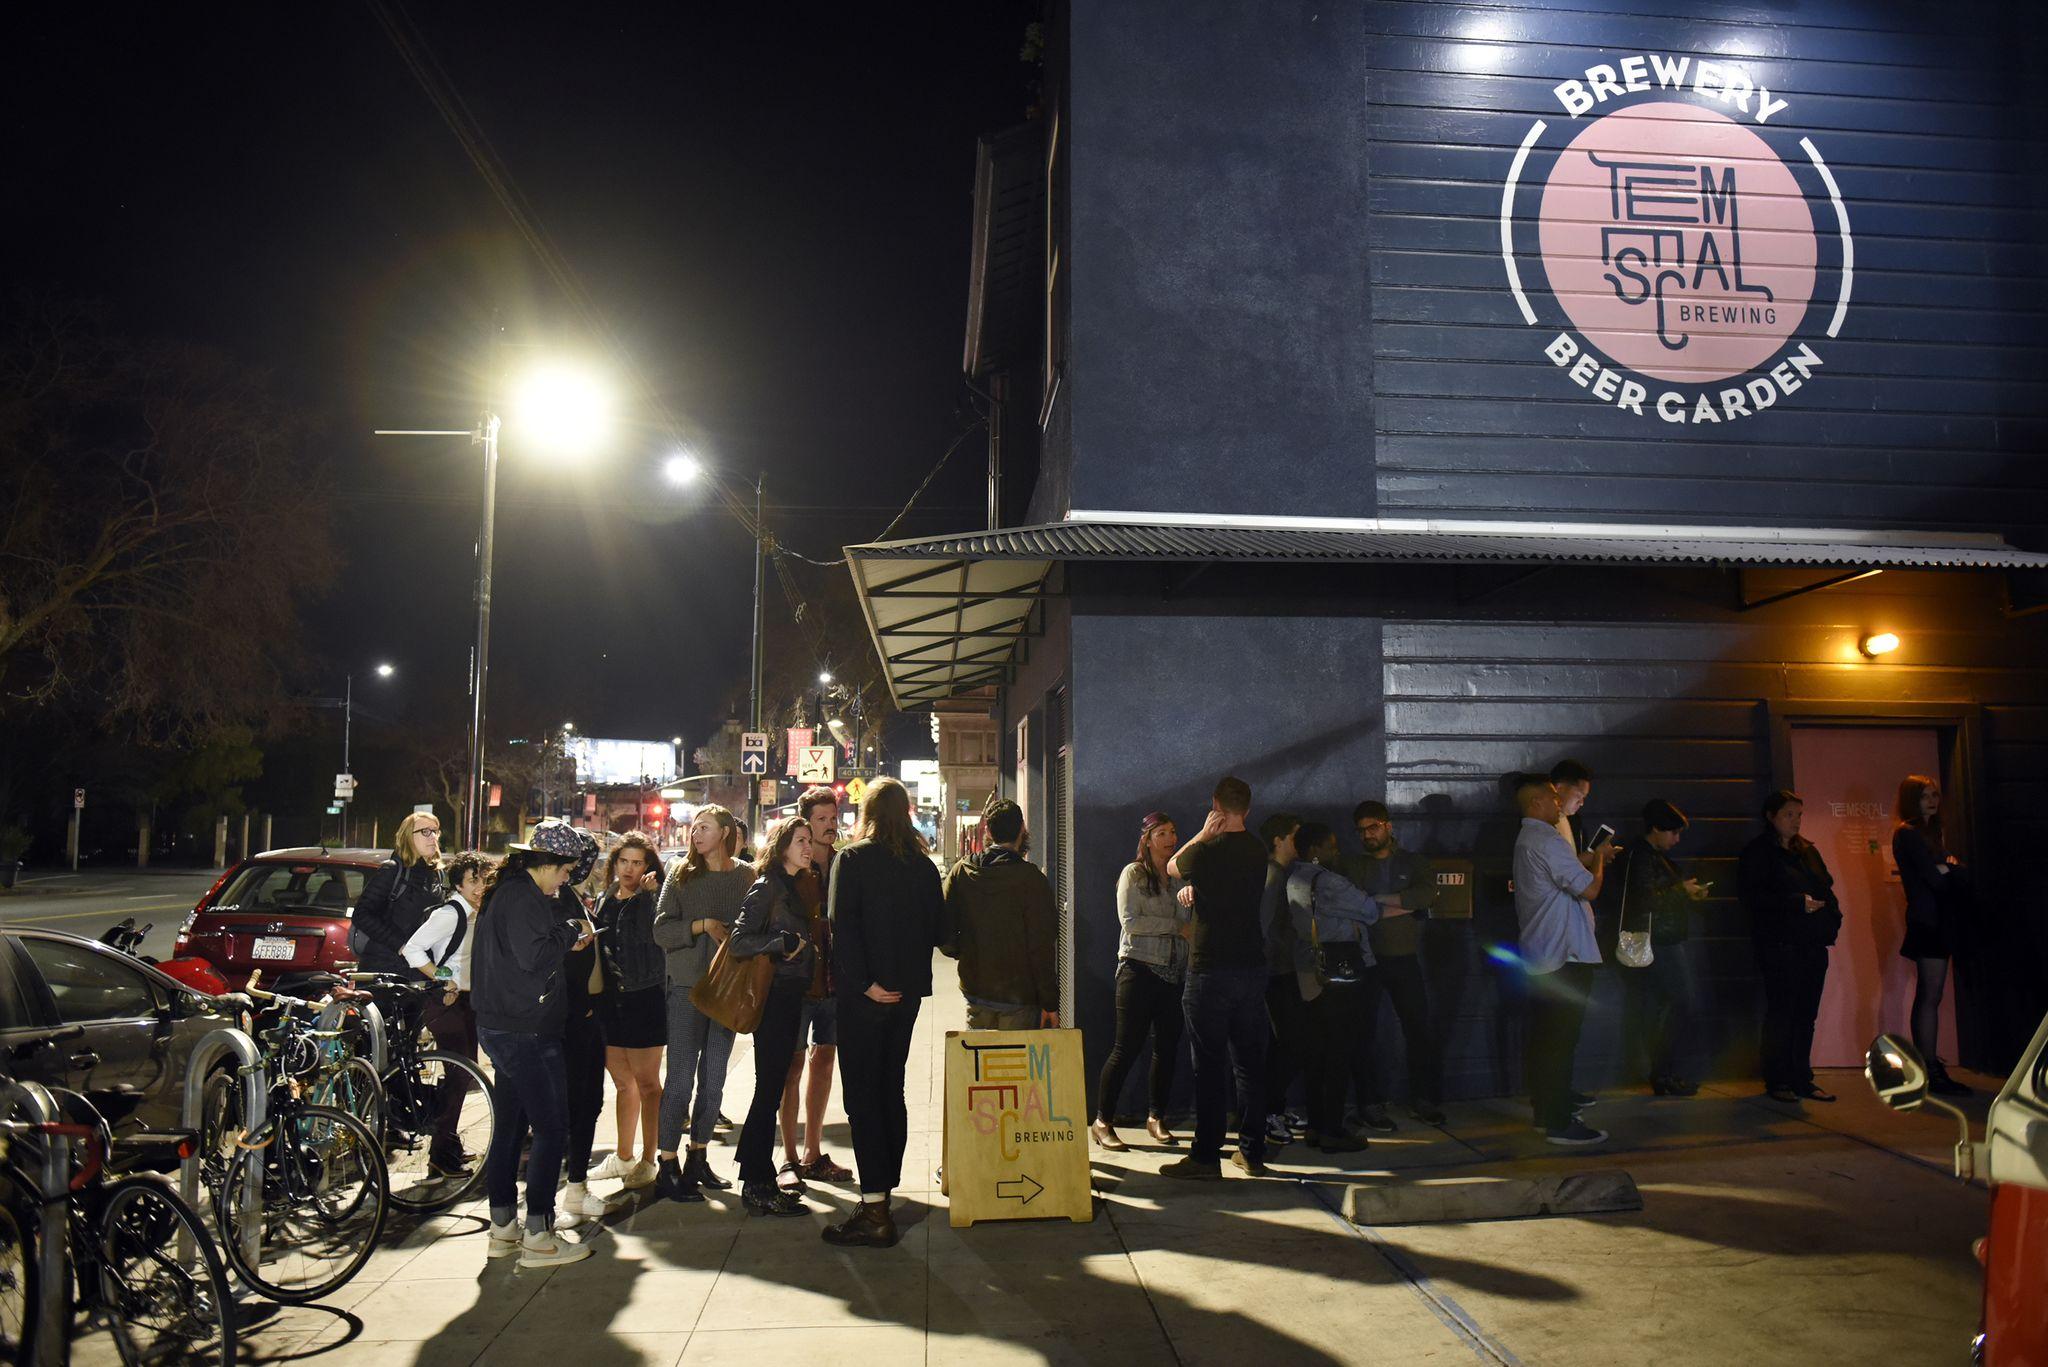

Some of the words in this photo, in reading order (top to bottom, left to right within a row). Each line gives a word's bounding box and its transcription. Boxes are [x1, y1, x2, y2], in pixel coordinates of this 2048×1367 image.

[1553, 55, 1788, 124] BREWERY
[1680, 304, 1777, 325] BREWING
[1544, 332, 1648, 415] BEER
[1656, 342, 1823, 424] GARDEN
[1438, 874, 1463, 884] 4117
[1014, 1130, 1074, 1143] BREWING
